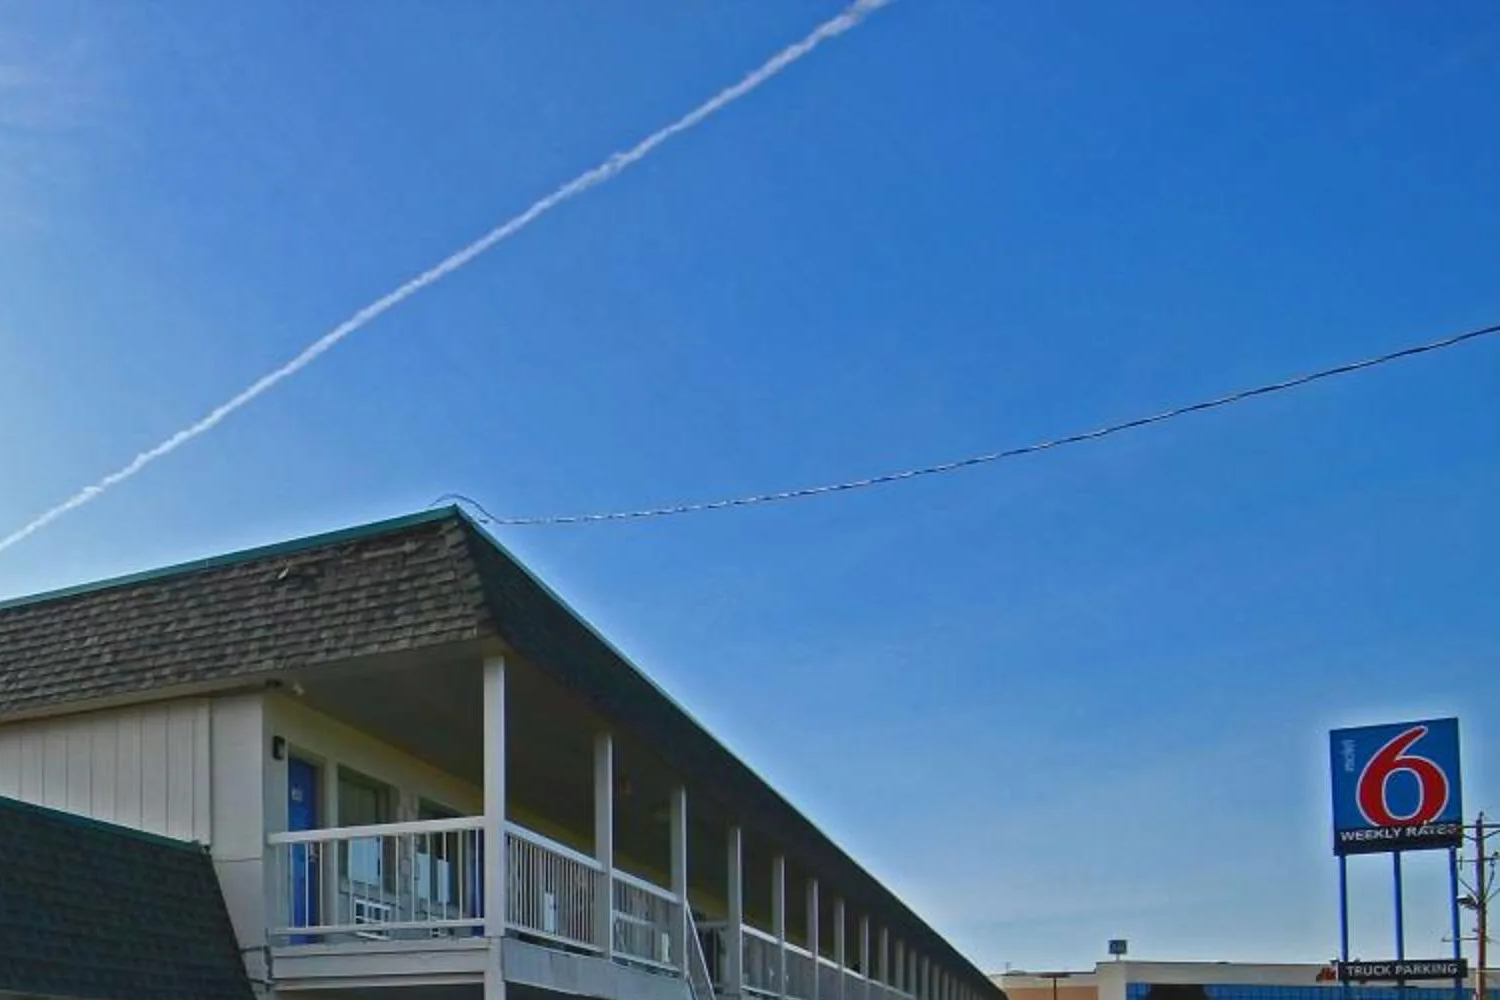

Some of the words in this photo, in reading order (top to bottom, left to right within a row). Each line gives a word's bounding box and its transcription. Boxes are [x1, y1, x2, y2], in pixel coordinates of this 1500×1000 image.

[1356, 725, 1449, 827] 6
[1340, 827, 1402, 842] WEEKLY
[1347, 965, 1391, 977] TRUCK
[1395, 963, 1458, 975] PARKING
